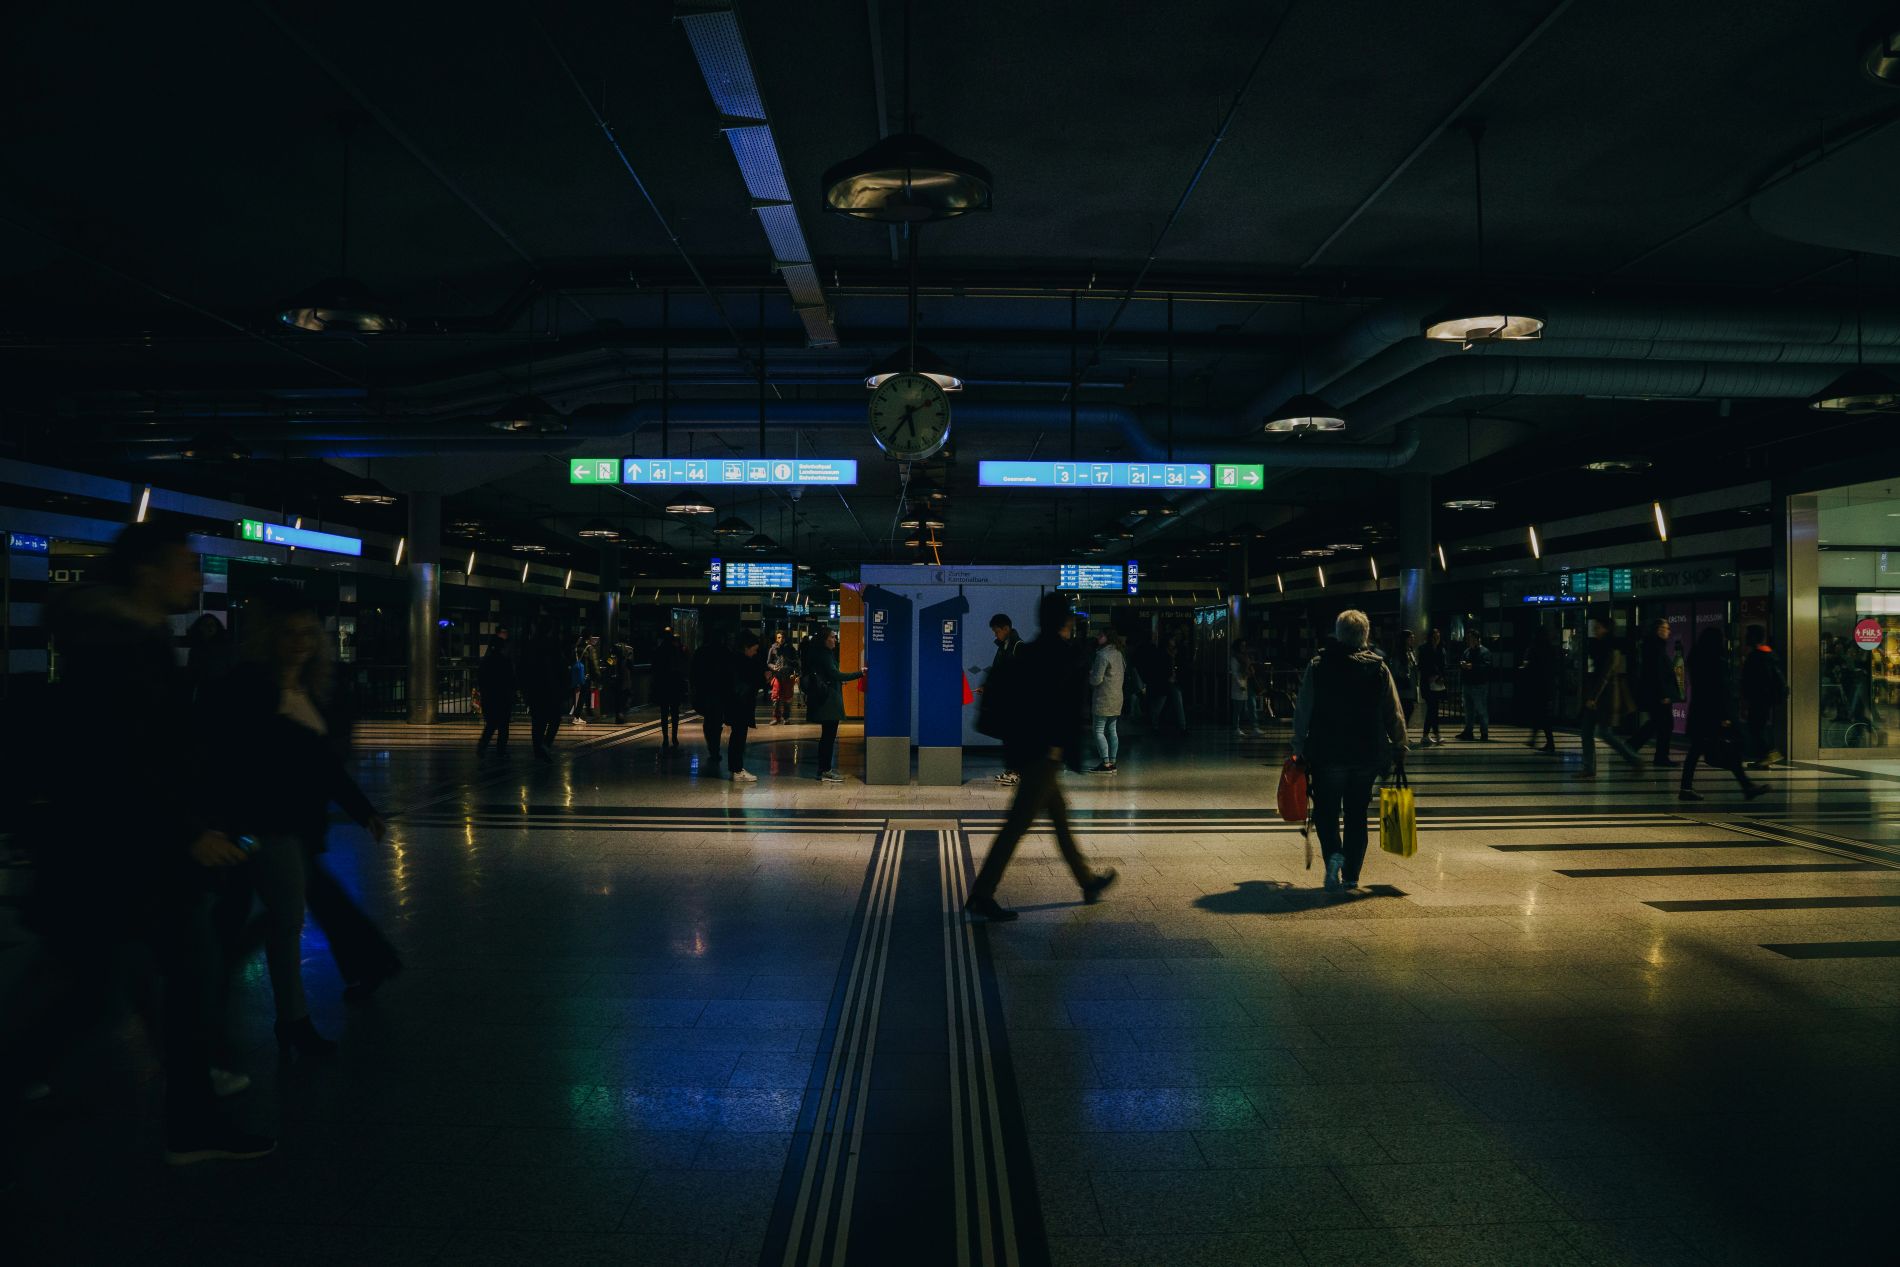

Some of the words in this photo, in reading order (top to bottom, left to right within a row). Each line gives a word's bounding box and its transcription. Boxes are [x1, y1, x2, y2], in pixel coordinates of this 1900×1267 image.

[653, 468, 666, 480] 41
[689, 468, 704, 480] 44
[1061, 472, 1069, 482] 3
[1096, 472, 1109, 483] 17
[1132, 472, 1145, 484] 21
[1167, 472, 1183, 484] 34
